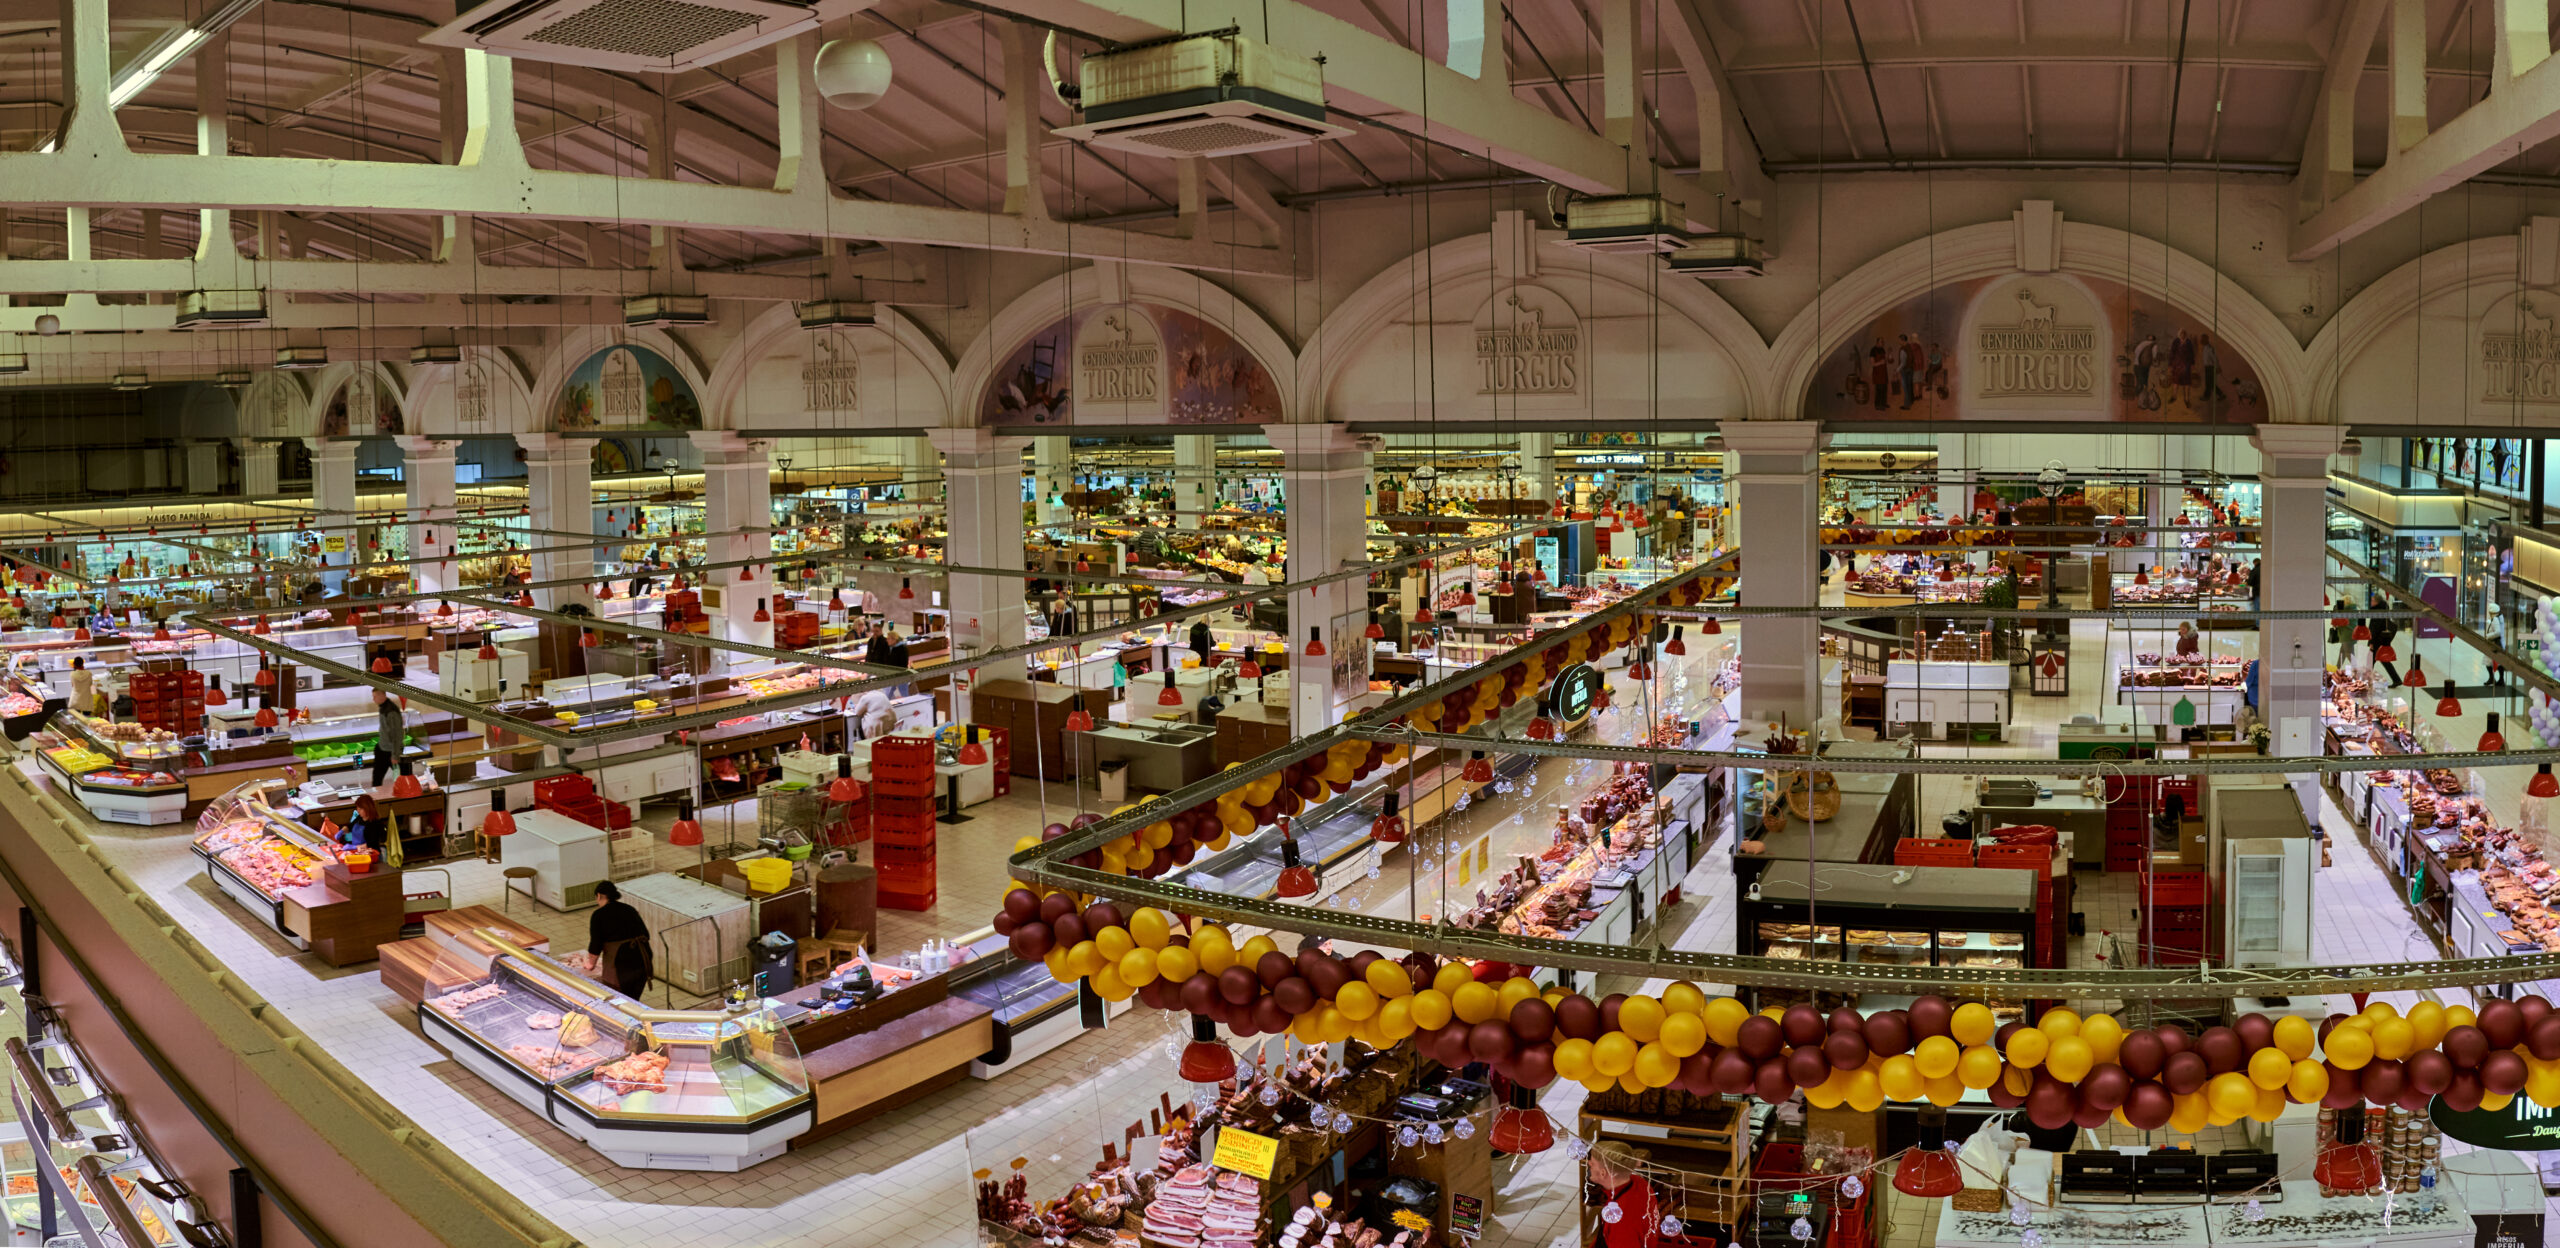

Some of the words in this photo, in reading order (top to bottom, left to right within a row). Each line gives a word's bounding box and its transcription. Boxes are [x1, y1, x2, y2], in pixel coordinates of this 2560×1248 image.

[1476, 335, 1533, 353] CENTRINIS
[1536, 334, 1577, 352] KAUNO
[1979, 333, 2044, 350] CENTRINIS
[2049, 333, 2095, 350] KAUNO
[2482, 341, 2543, 359] CENTRINIS
[1082, 351, 1124, 367] CENTRINIS
[1125, 349, 1158, 366] KAUNO
[1477, 354, 1576, 391] TURGUS
[1980, 354, 2093, 391] TURGUS
[1083, 367, 1157, 399] TURGUS
[802, 381, 857, 408] TURGUS
[146, 514, 176, 523] MAISTO
[179, 512, 213, 521] PAPILDAI
